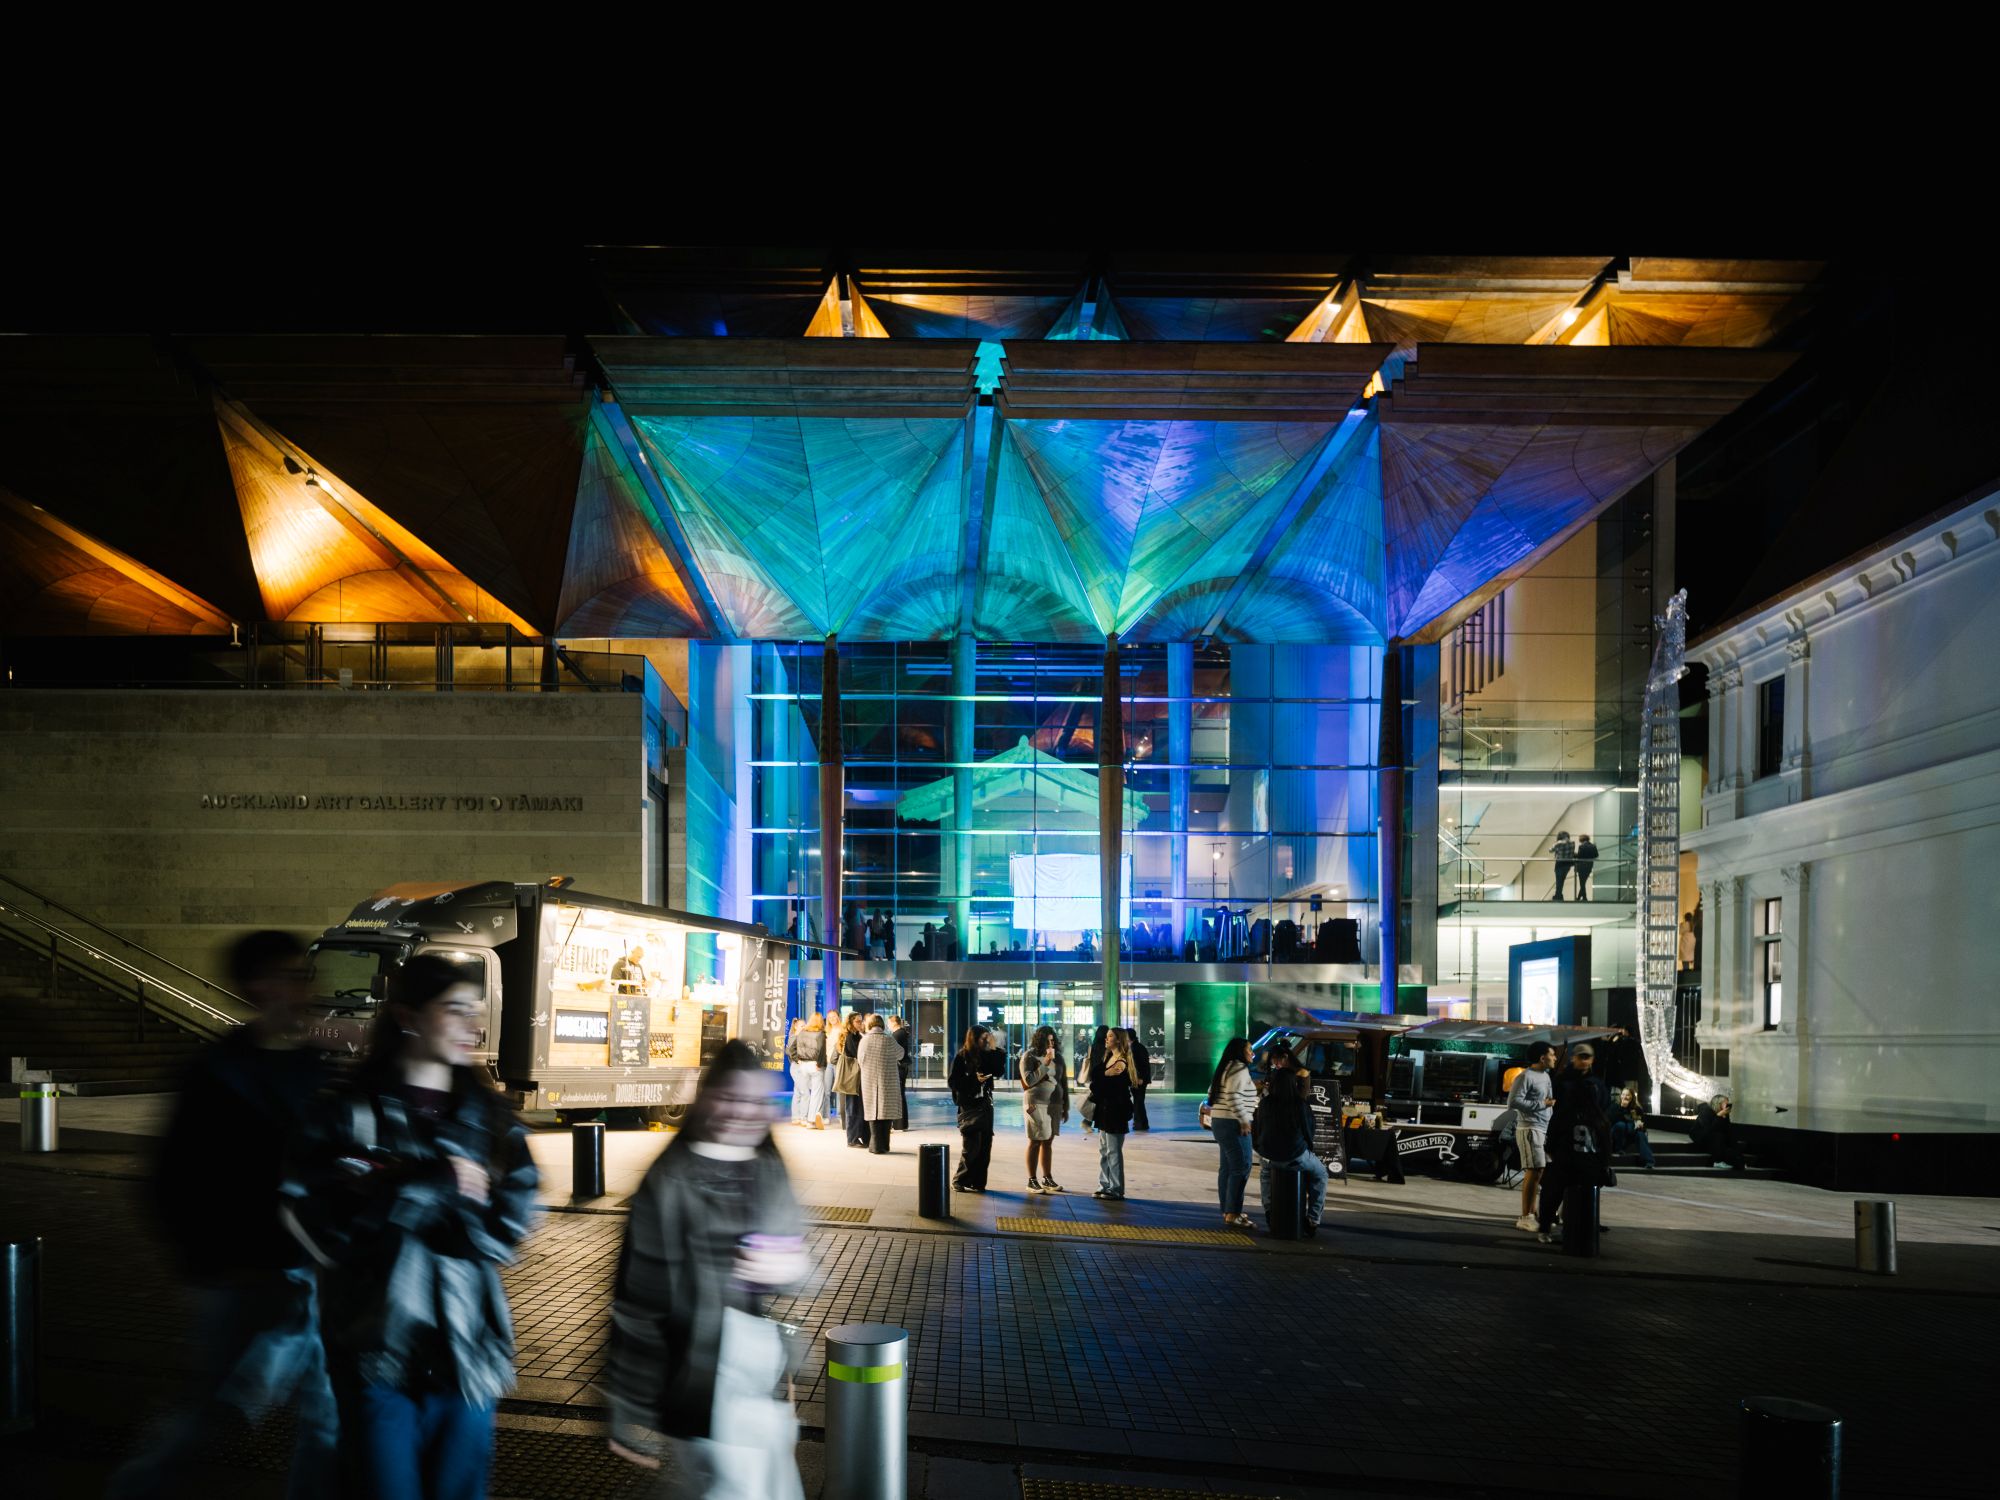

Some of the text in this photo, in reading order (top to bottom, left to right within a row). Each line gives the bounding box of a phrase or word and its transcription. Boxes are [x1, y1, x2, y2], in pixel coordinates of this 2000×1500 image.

[201, 794, 309, 810] AUCKLAND
[315, 795, 353, 810] ART
[360, 796, 445, 811] GALLERY
[452, 796, 484, 811] TOI
[506, 794, 583, 811] TĀMAKI
[1397, 1136, 1448, 1152] IONEER PIES
